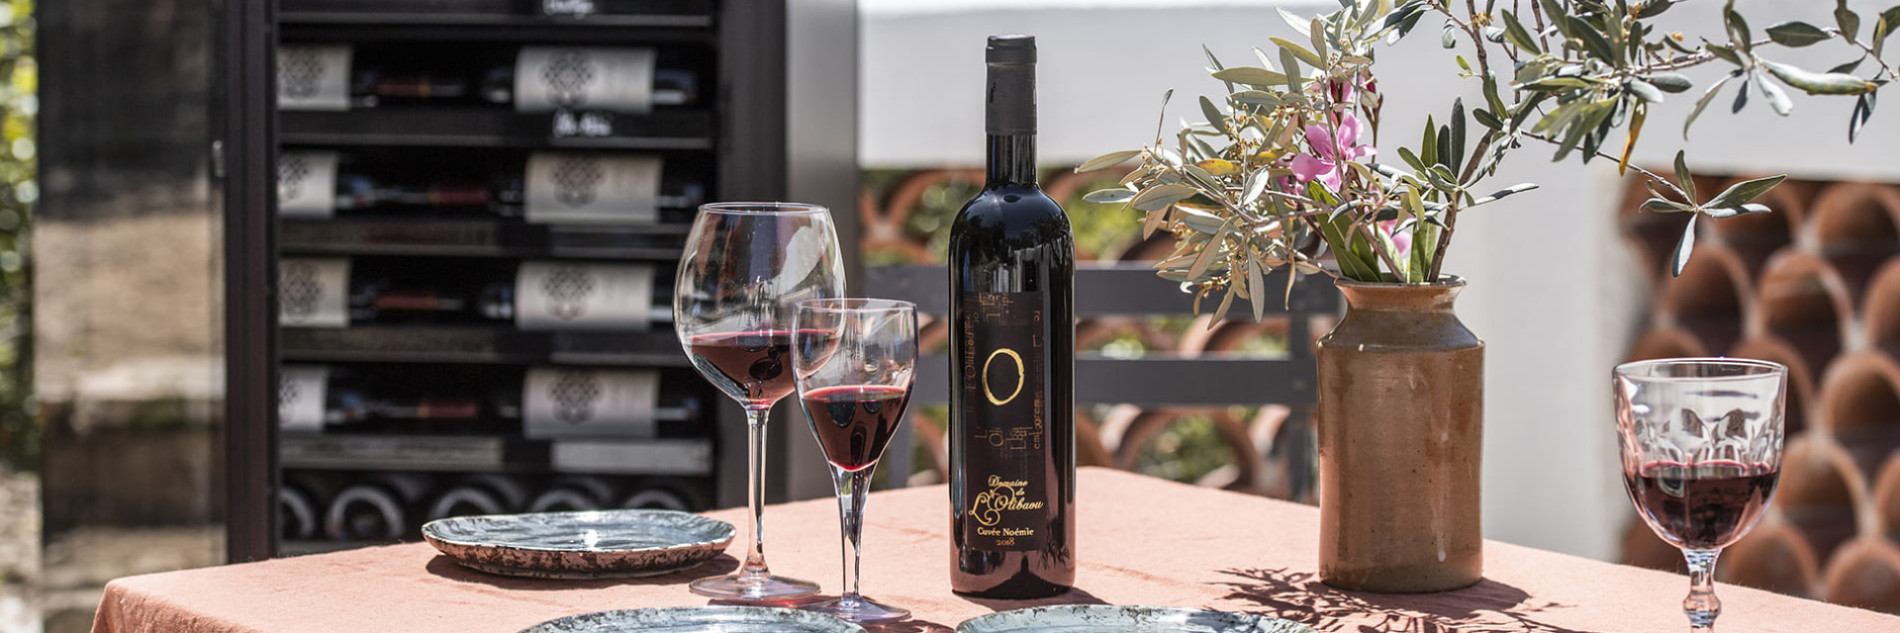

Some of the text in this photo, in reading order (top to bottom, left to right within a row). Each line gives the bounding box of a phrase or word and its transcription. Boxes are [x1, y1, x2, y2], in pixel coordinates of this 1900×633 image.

[988, 475, 1028, 487] Domaine
[1016, 488, 1025, 497] de
[977, 527, 1034, 536] Cuvée Noémie
